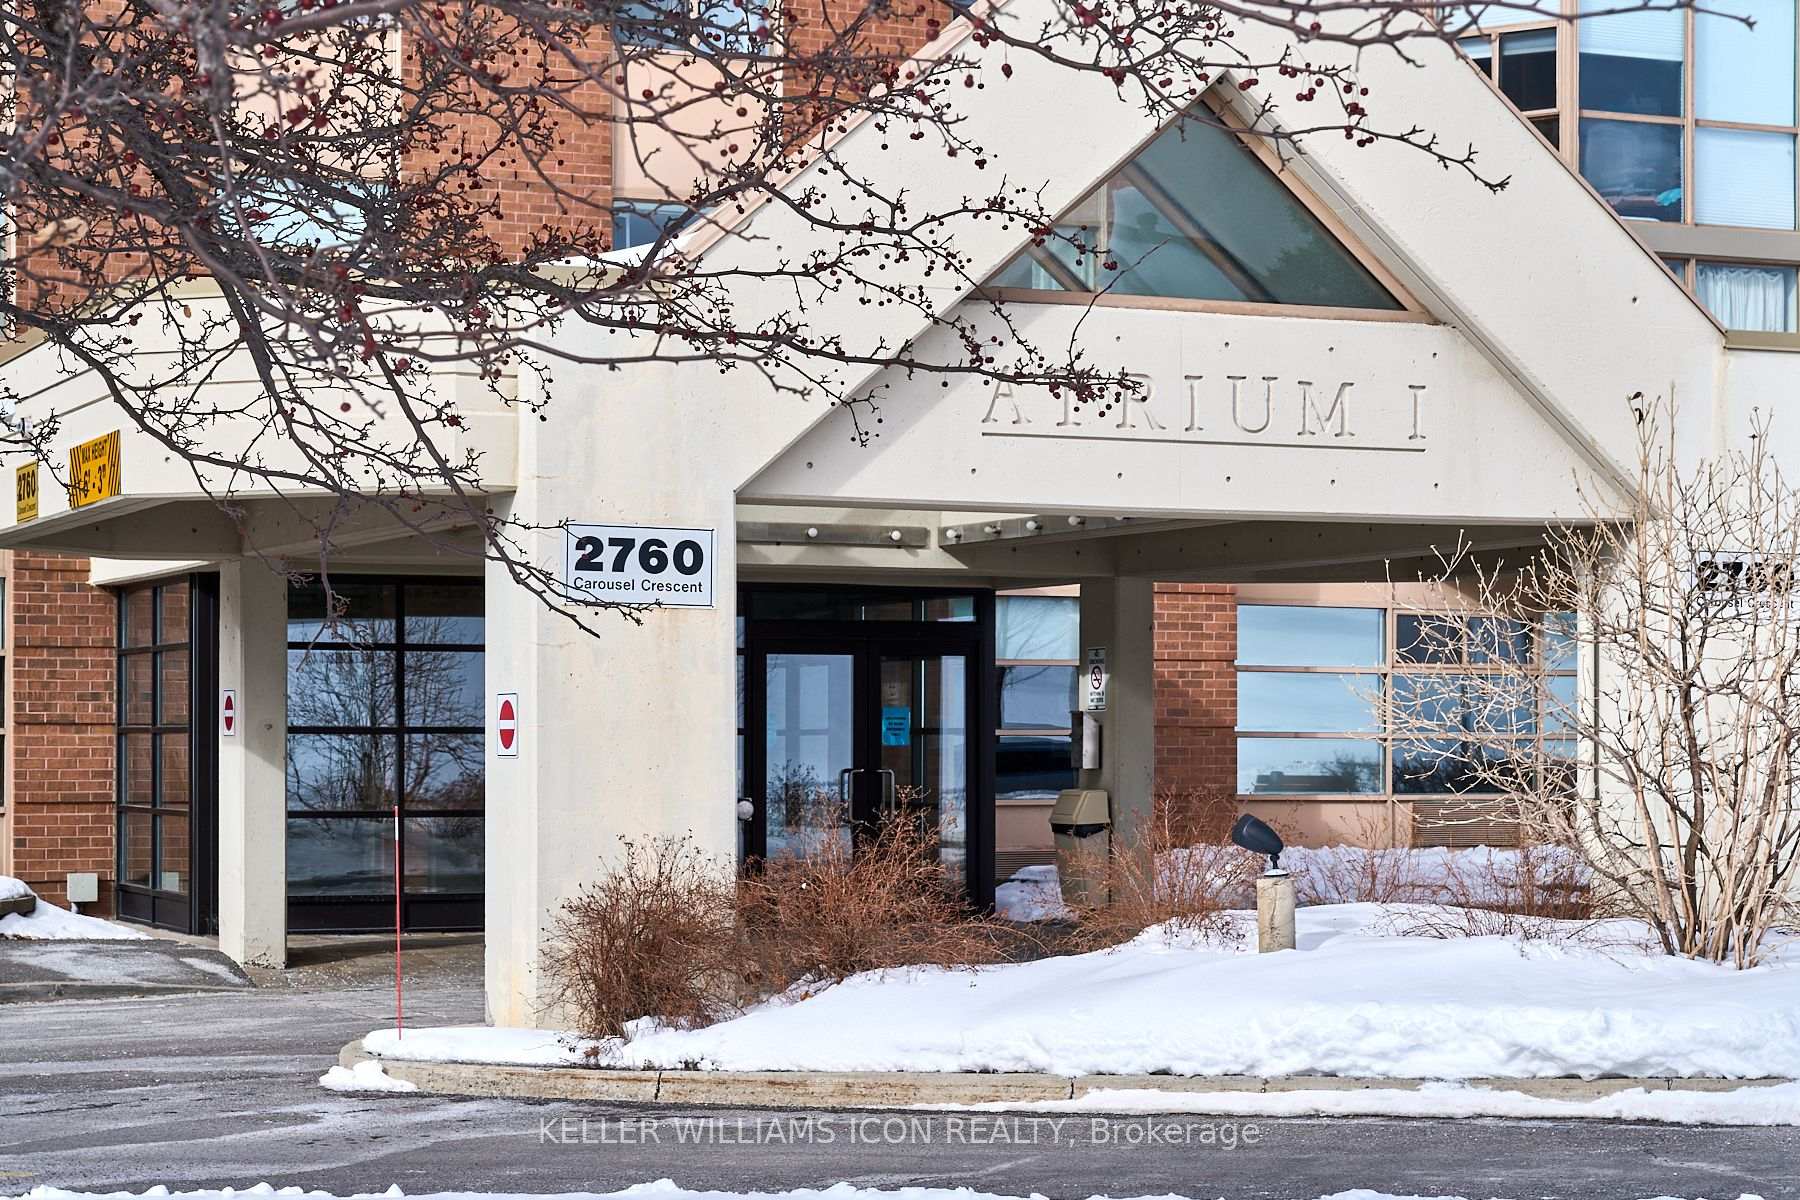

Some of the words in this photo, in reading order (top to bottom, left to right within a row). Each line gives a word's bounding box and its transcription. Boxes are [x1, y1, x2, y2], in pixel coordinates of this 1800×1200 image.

[981, 365, 1355, 437] ATRIUM
[17, 469, 36, 502] 2760
[574, 535, 704, 576] 2760
[574, 577, 635, 591] Carousel
[641, 579, 703, 593] Crescent
